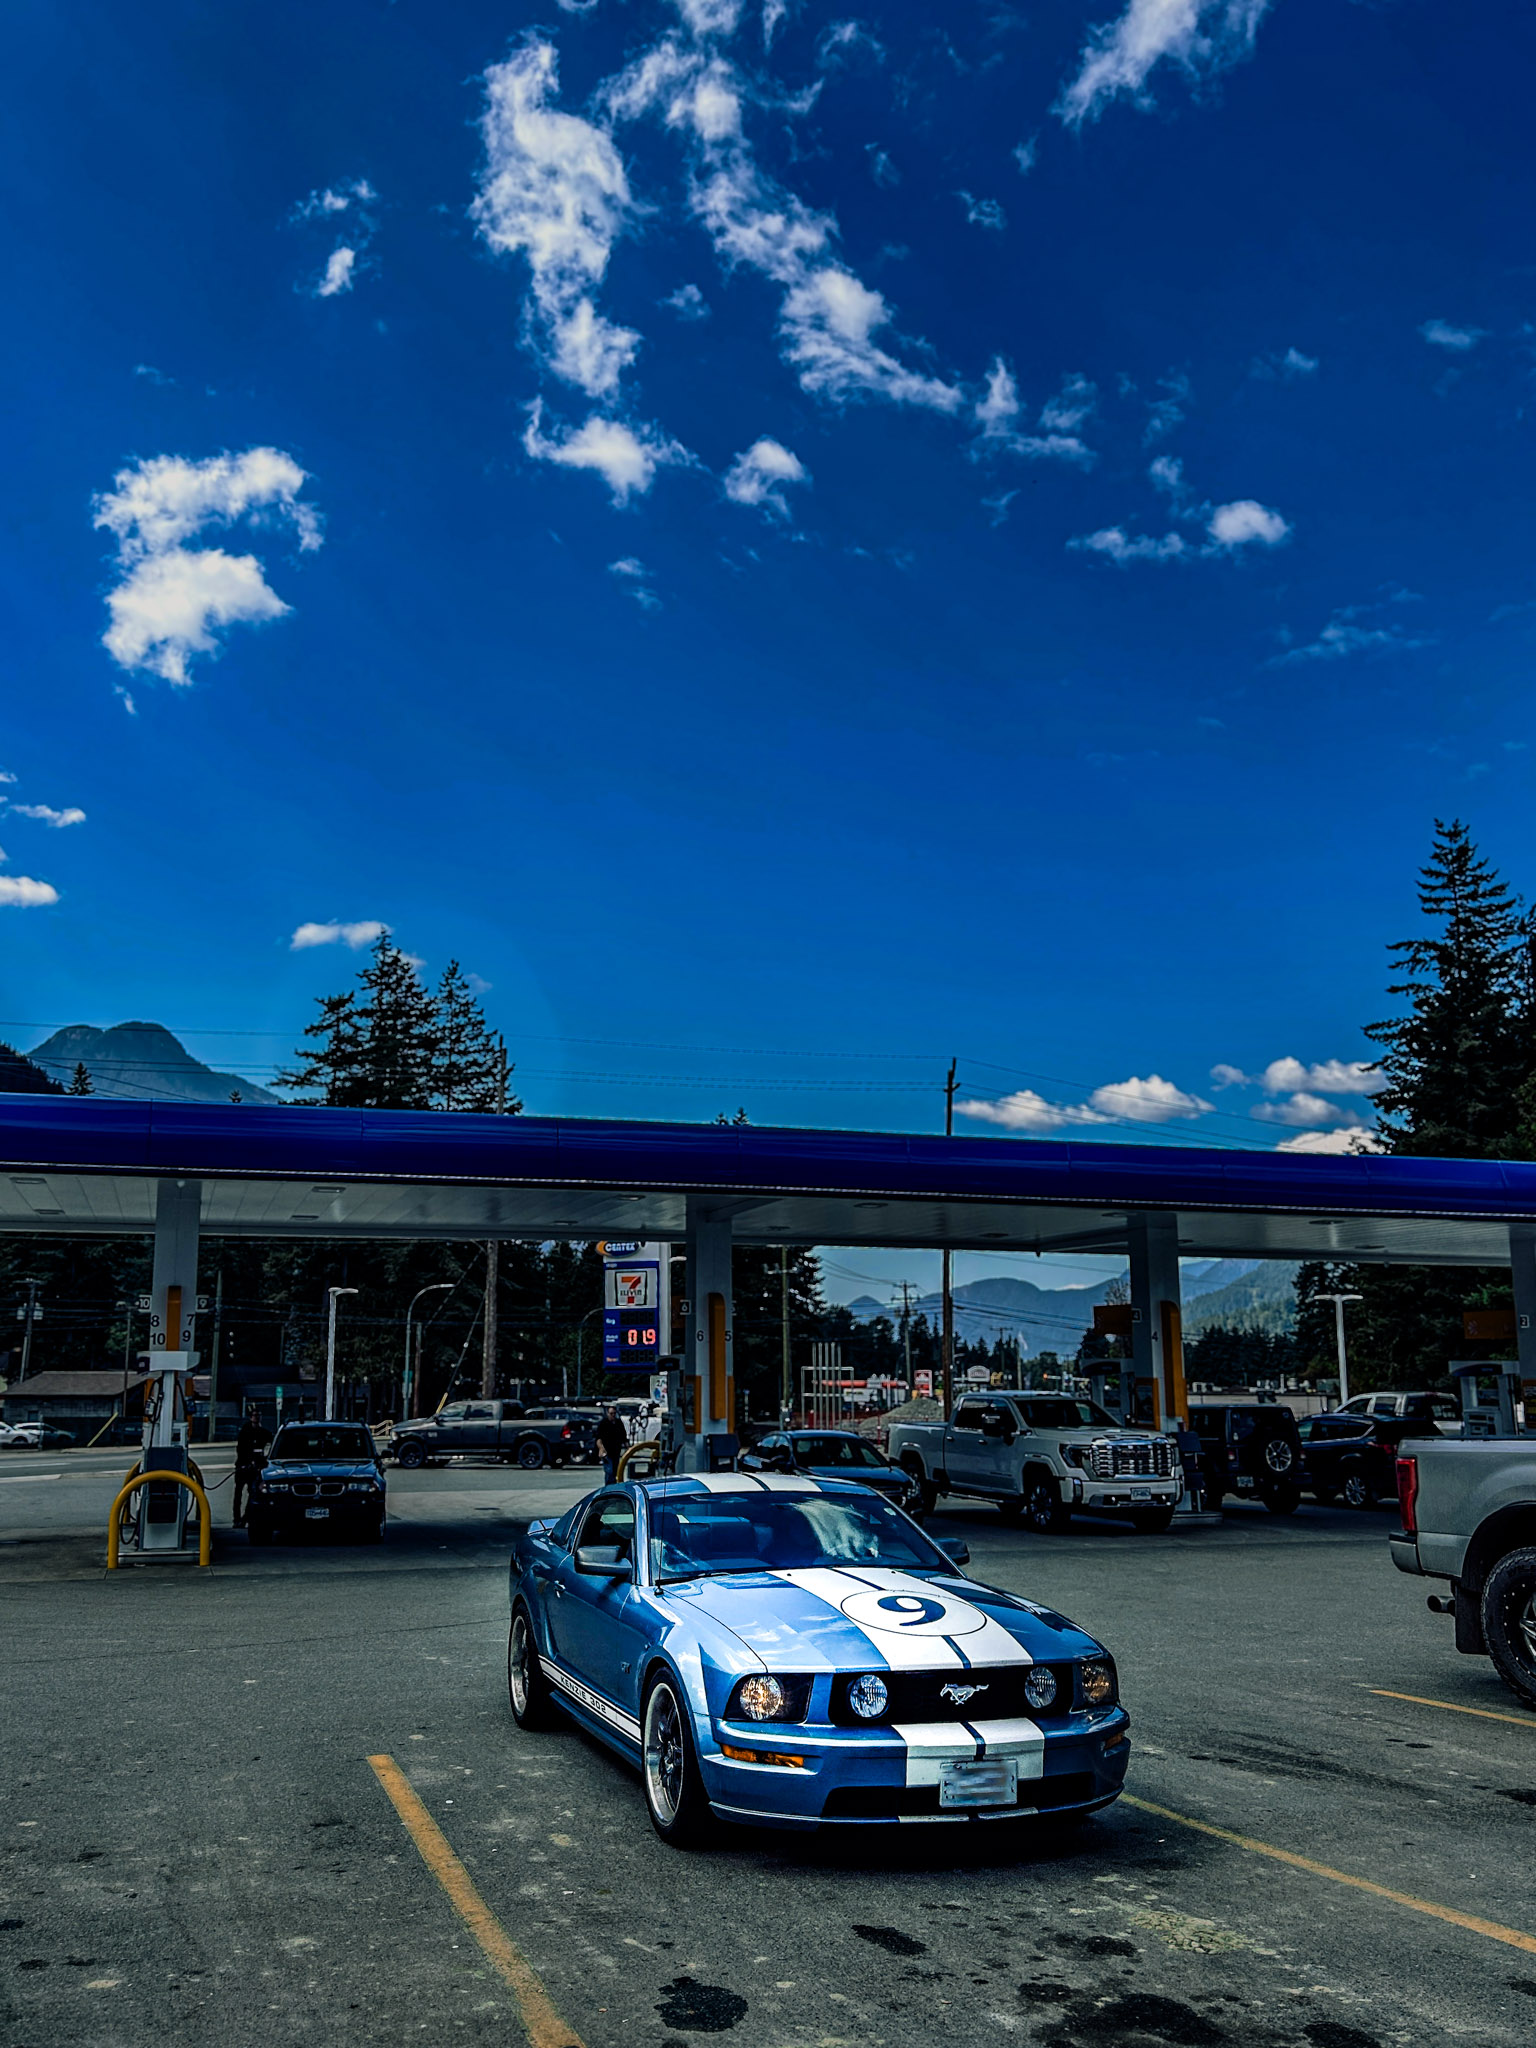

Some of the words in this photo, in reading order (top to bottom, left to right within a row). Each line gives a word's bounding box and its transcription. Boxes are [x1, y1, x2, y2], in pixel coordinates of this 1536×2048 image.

[605, 1243, 635, 1251] CENTEX
[621, 1276, 641, 1304] 7
[140, 1299, 150, 1308] 10
[199, 1299, 207, 1308] 9
[682, 1304, 688, 1312] 6
[151, 1315, 159, 1327] 8
[187, 1314, 195, 1326] 7
[1521, 1317, 1527, 1325] 2
[151, 1333, 166, 1345] 10
[183, 1330, 191, 1342] 9
[697, 1330, 704, 1342] 6
[725, 1331, 732, 1342] 5
[1152, 1332, 1158, 1342] 4
[877, 1595, 946, 1626] 9
[560, 1675, 587, 1700] KENZIE
[590, 1697, 607, 1714] 302
